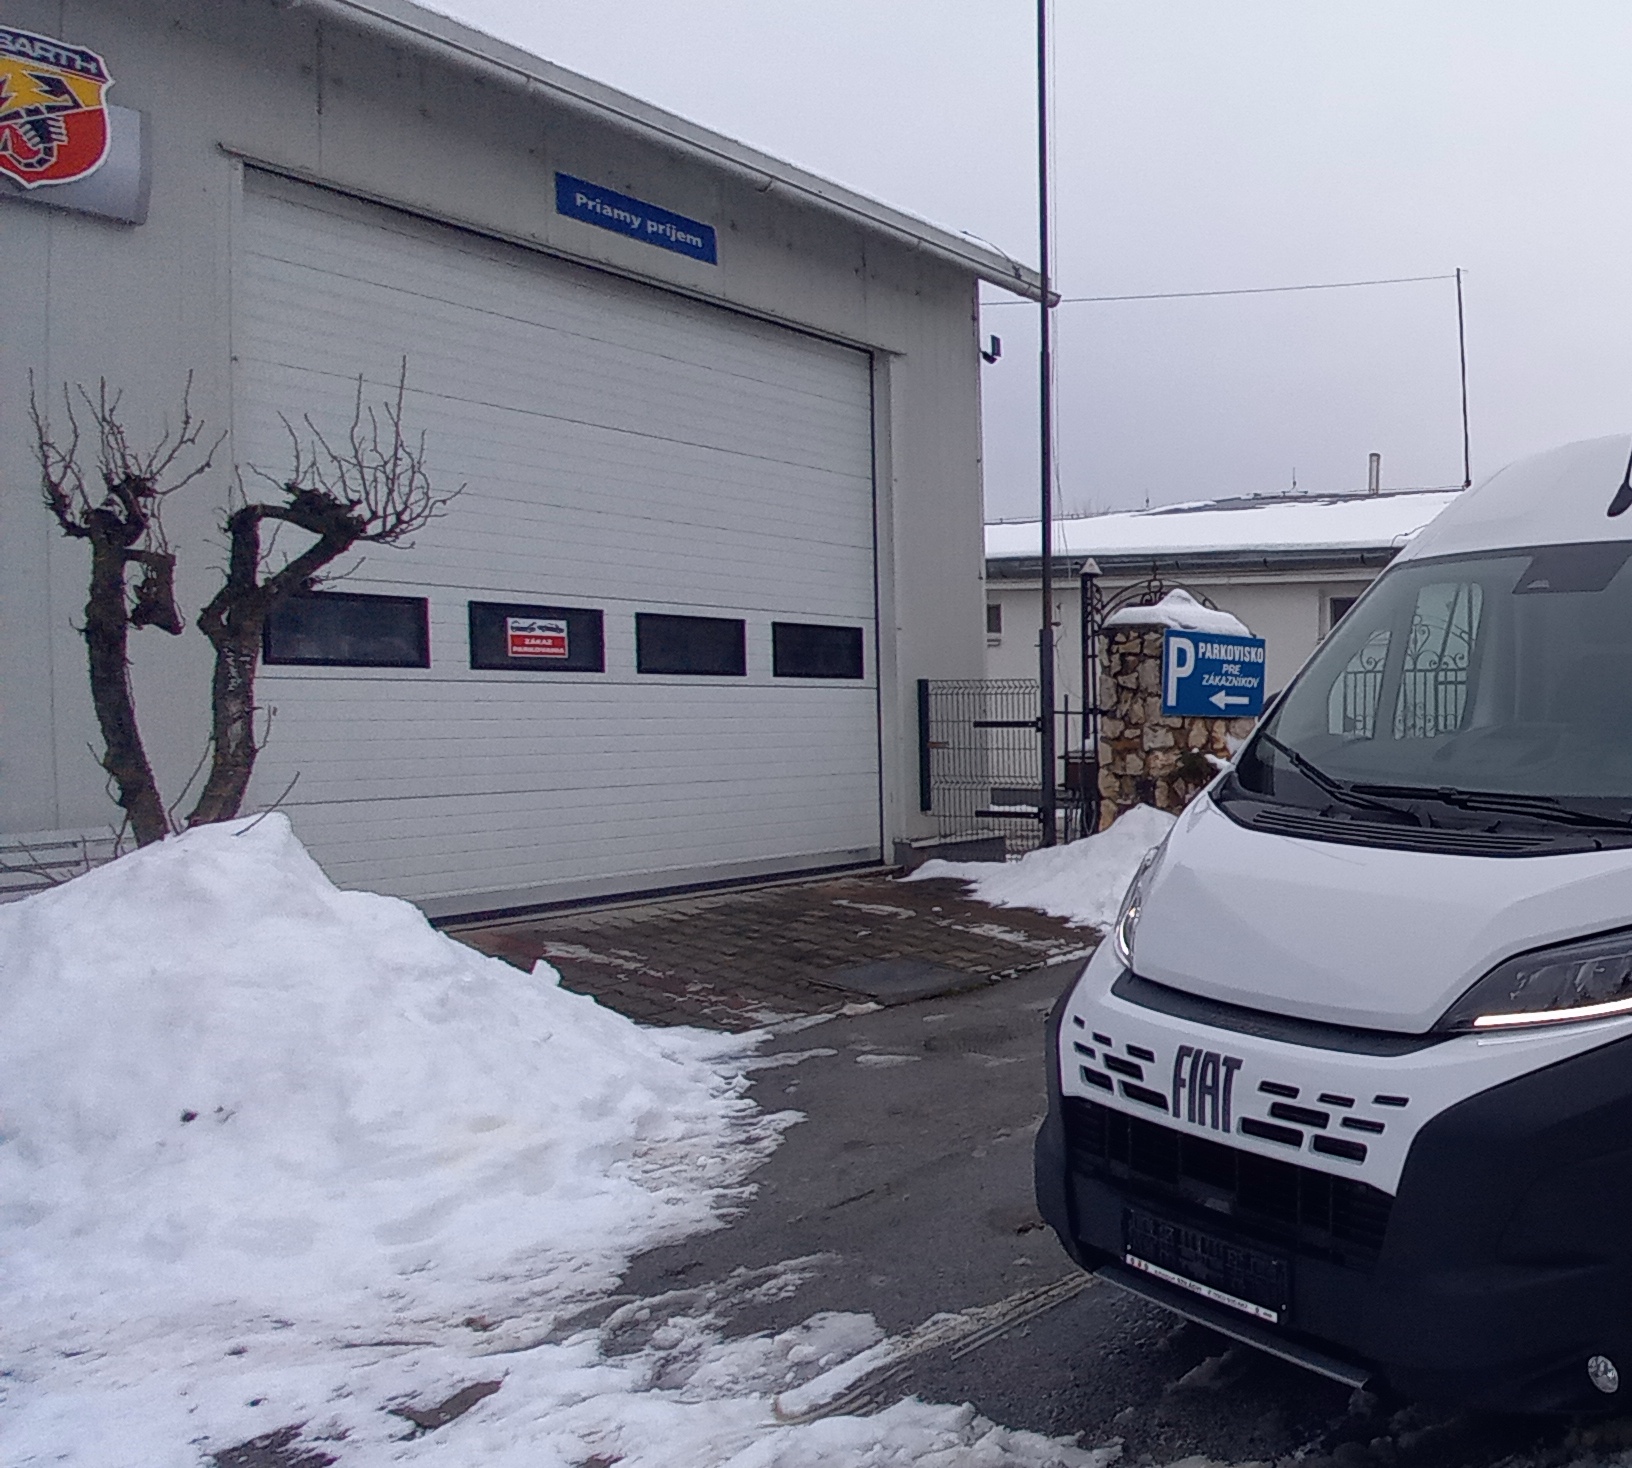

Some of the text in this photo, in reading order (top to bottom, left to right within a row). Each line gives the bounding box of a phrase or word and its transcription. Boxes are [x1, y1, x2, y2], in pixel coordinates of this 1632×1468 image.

[575, 192, 702, 248] Priamy príjem
[1166, 636, 1196, 707] P
[1198, 642, 1264, 663] PARKOVISKO
[1221, 663, 1241, 675] PRE
[1201, 672, 1260, 688] ZÁKAZNÍKOV
[1172, 1044, 1244, 1133] FIAT
